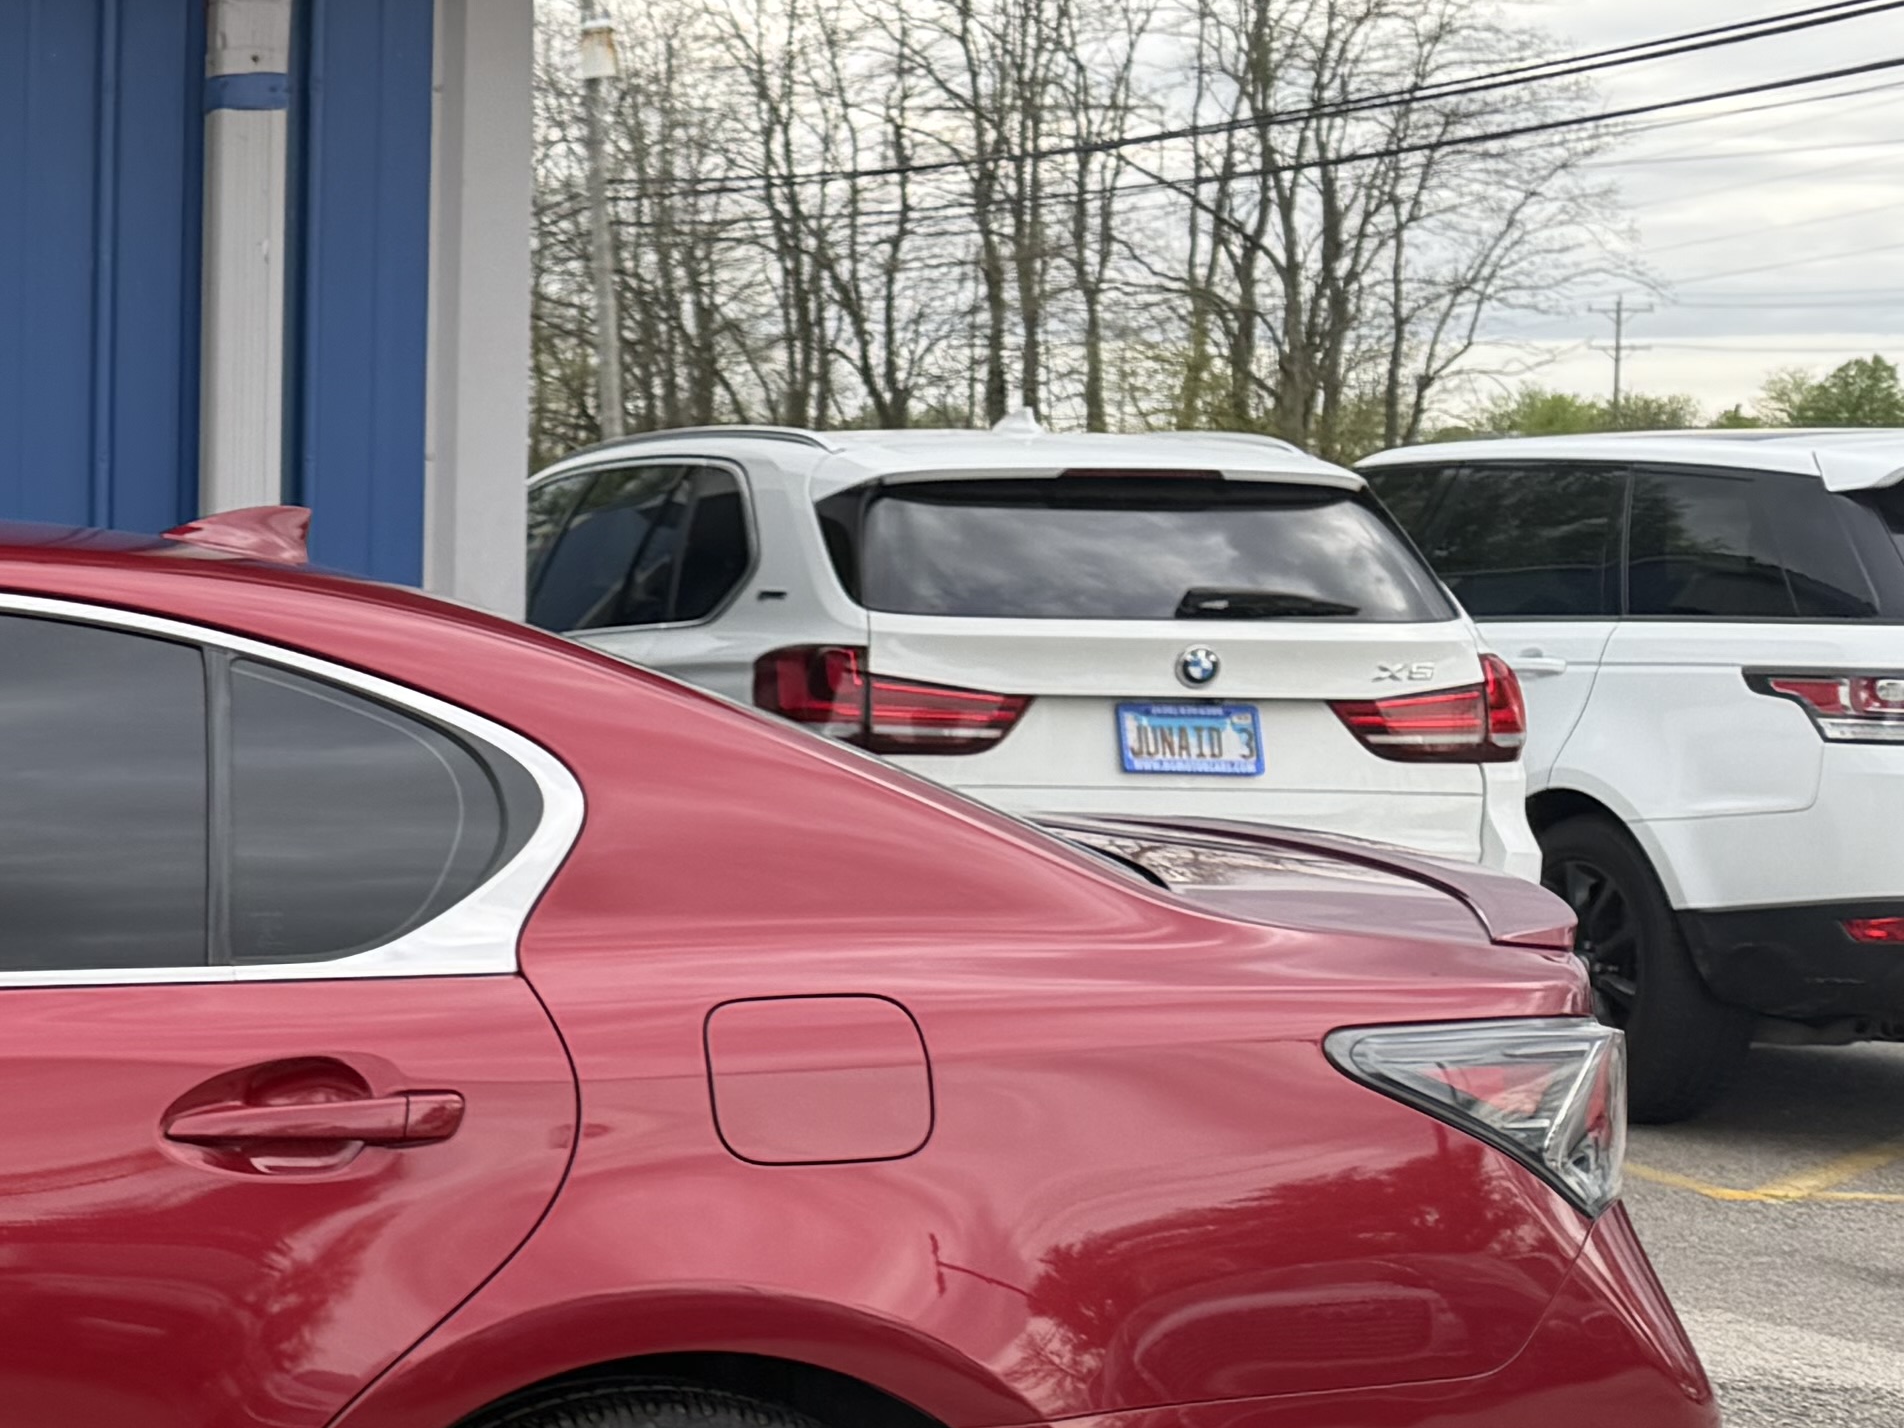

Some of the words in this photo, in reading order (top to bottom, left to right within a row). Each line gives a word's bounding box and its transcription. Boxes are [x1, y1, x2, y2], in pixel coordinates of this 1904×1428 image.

[1371, 662, 1434, 683] X5
[1130, 725, 1223, 758] JUNAID
[1239, 727, 1255, 759] 3
